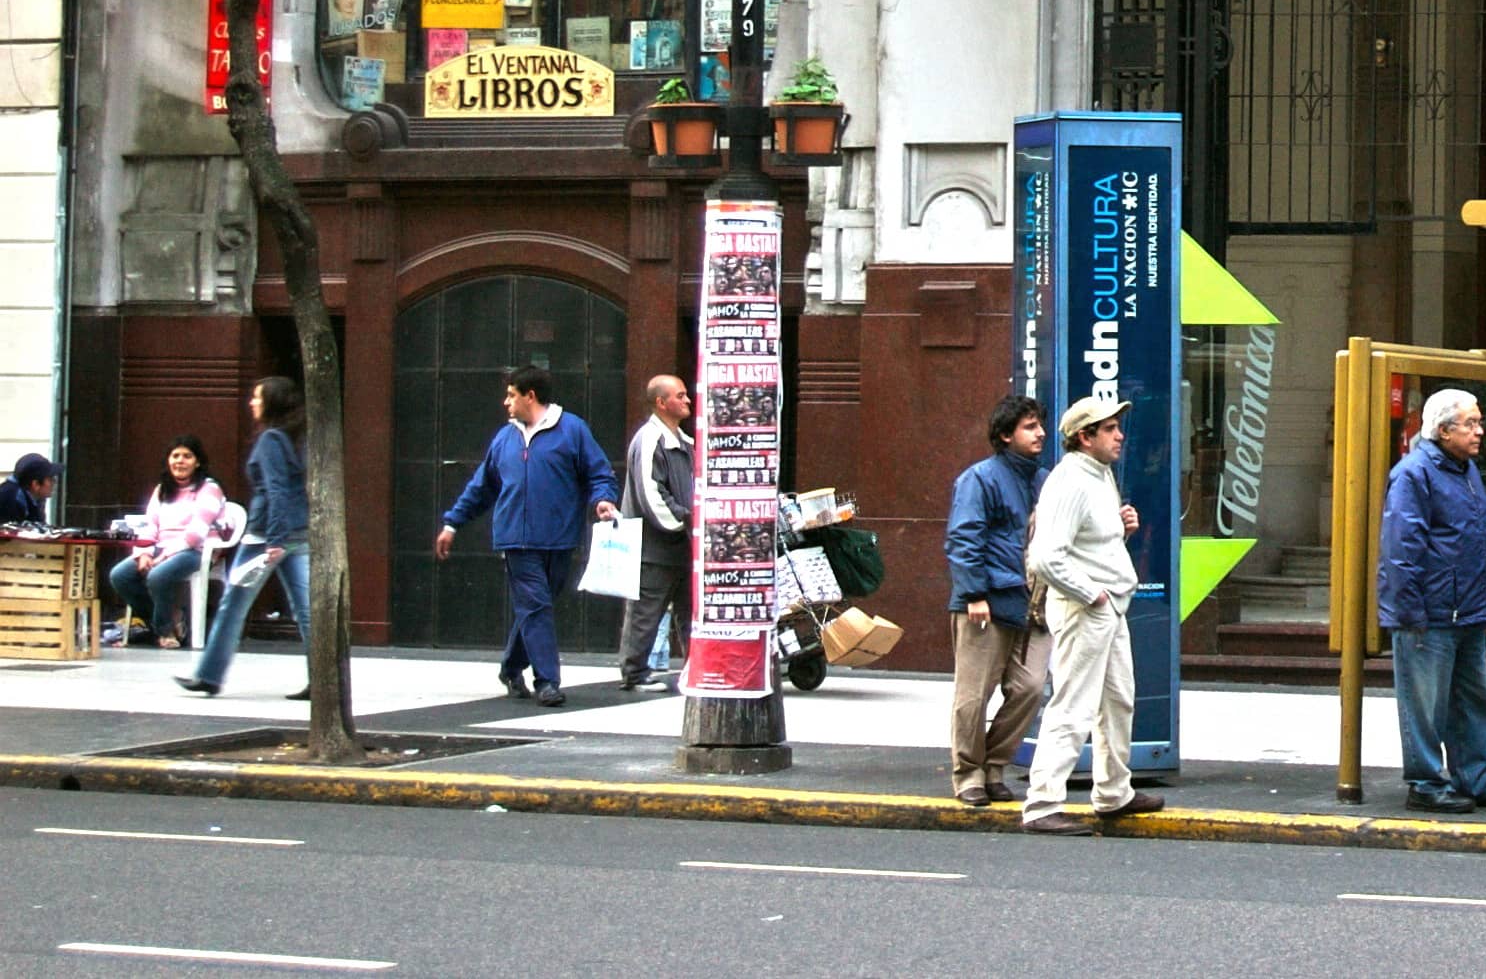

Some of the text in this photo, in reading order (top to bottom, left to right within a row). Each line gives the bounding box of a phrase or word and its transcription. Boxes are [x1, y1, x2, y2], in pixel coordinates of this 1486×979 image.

[211, 49, 271, 74] TAO
[467, 53, 585, 76] EL VENTANAL
[458, 78, 584, 109] LIBROS
[1124, 214, 1137, 288] NACION
[1148, 236, 1158, 288] NUESTRA
[1124, 293, 1137, 318] LA
